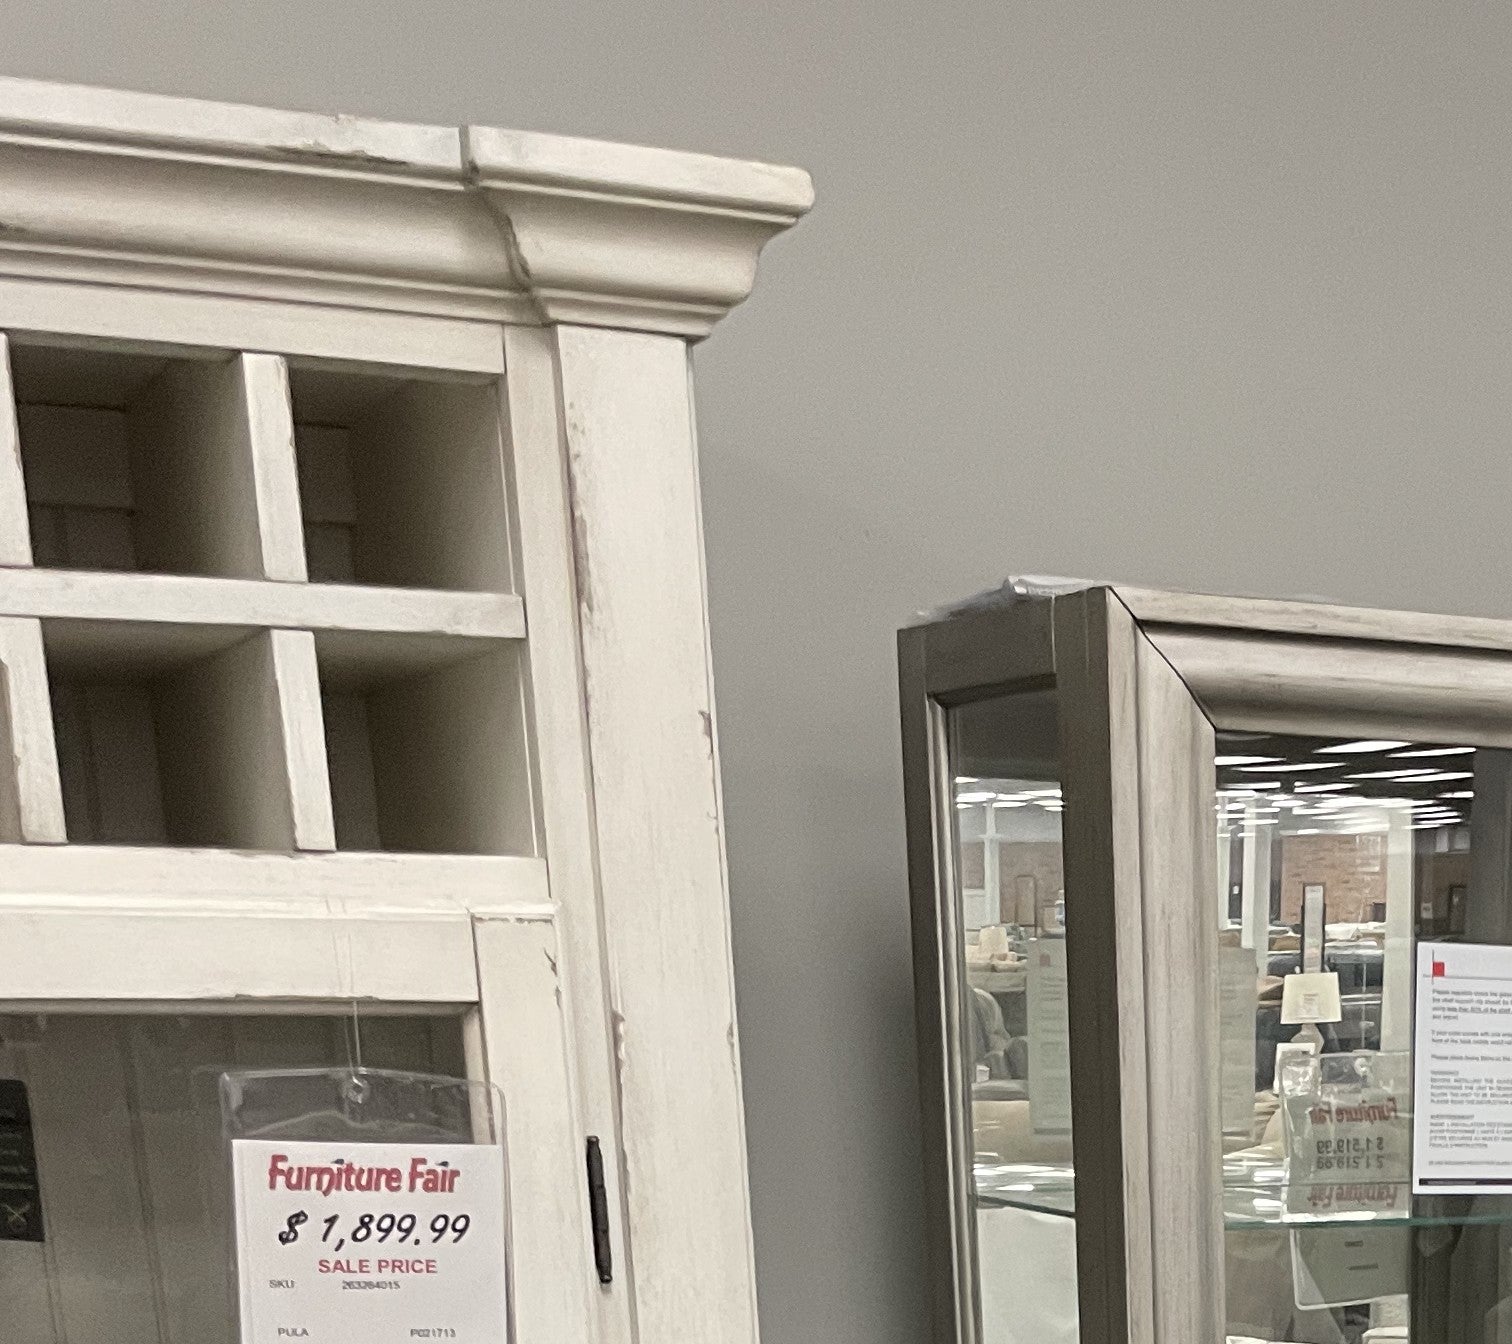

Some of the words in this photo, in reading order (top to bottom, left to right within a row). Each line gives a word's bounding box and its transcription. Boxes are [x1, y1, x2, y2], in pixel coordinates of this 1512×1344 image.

[268, 1154, 401, 1197] Furniture
[409, 1157, 460, 1194] Fair
[278, 1210, 308, 1246] $
[321, 1213, 471, 1252] 1,899.99
[318, 1259, 370, 1275] SALE
[377, 1259, 438, 1275] PRICE
[278, 1328, 309, 1338] PULA
